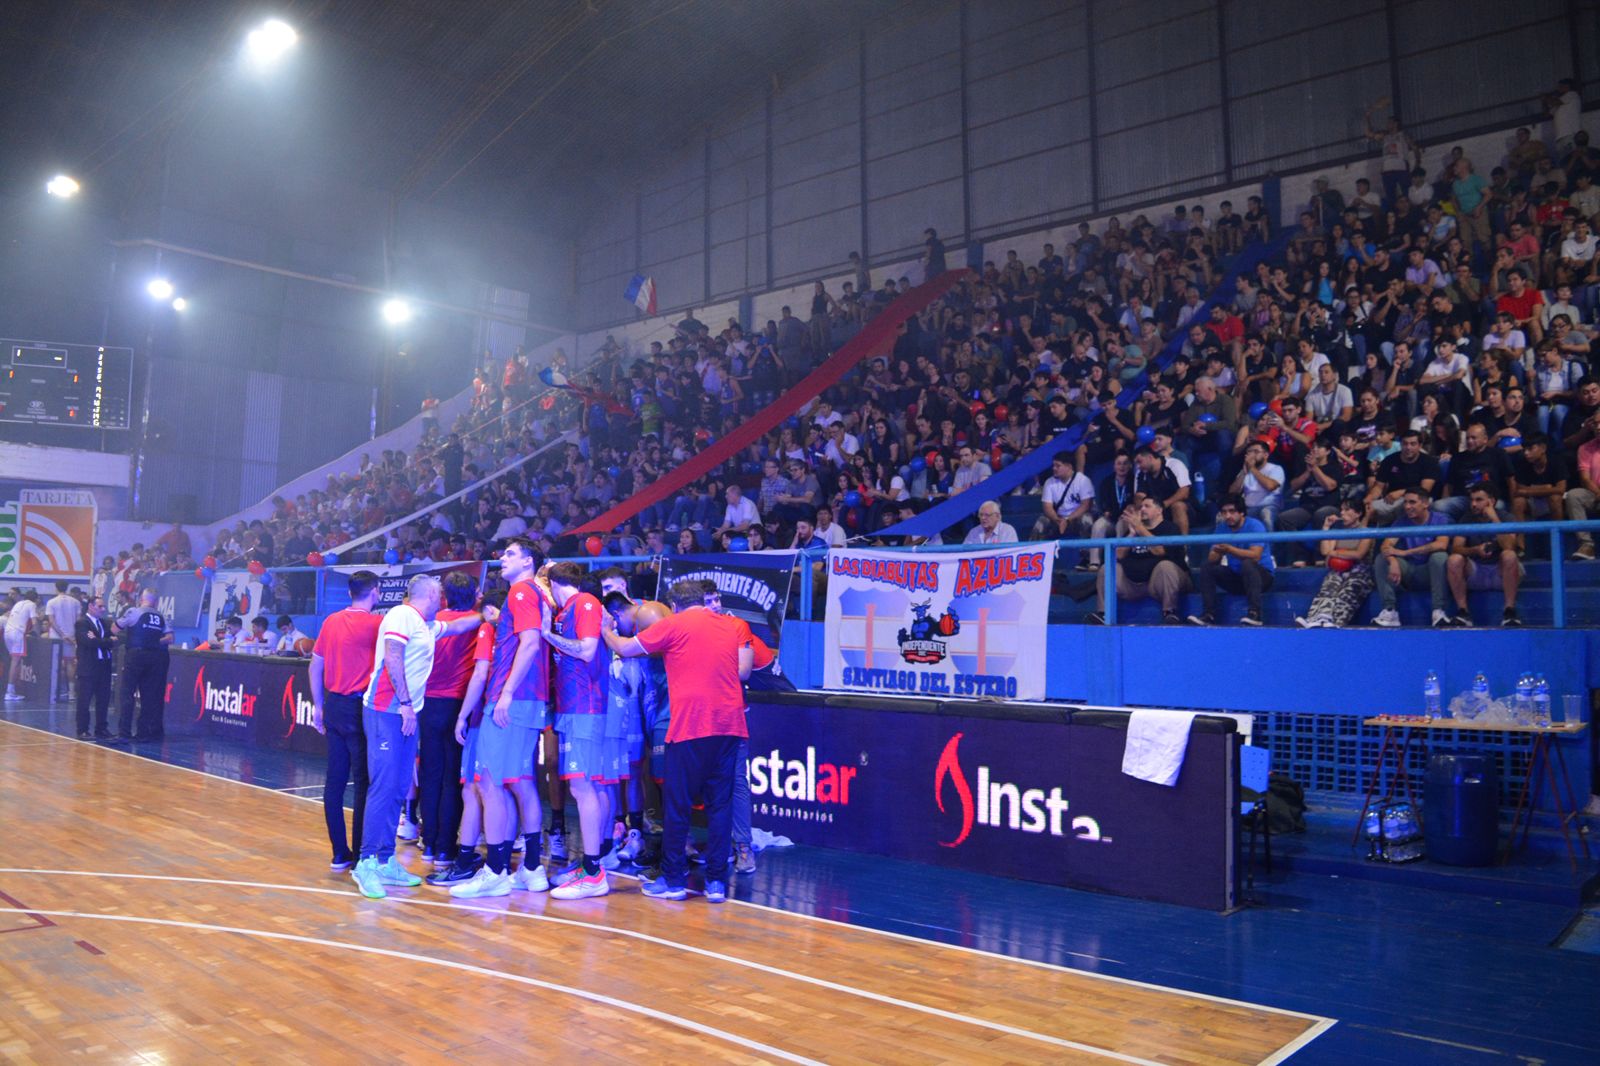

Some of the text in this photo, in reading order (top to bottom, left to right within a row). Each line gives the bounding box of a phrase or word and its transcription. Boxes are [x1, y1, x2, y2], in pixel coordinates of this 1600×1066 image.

[23, 491, 94, 505] TARJETA
[667, 571, 777, 611] IDIENTE BBC
[833, 552, 1046, 598] LAS DIABLITAS AZULES
[149, 614, 161, 626] 13
[205, 681, 257, 717] Instalar
[843, 666, 1017, 698] SANTIAGO DEL ESTERO
[746, 746, 857, 805] stalar
[771, 804, 833, 823] Sanitarios
[977, 766, 1113, 843] Insta
